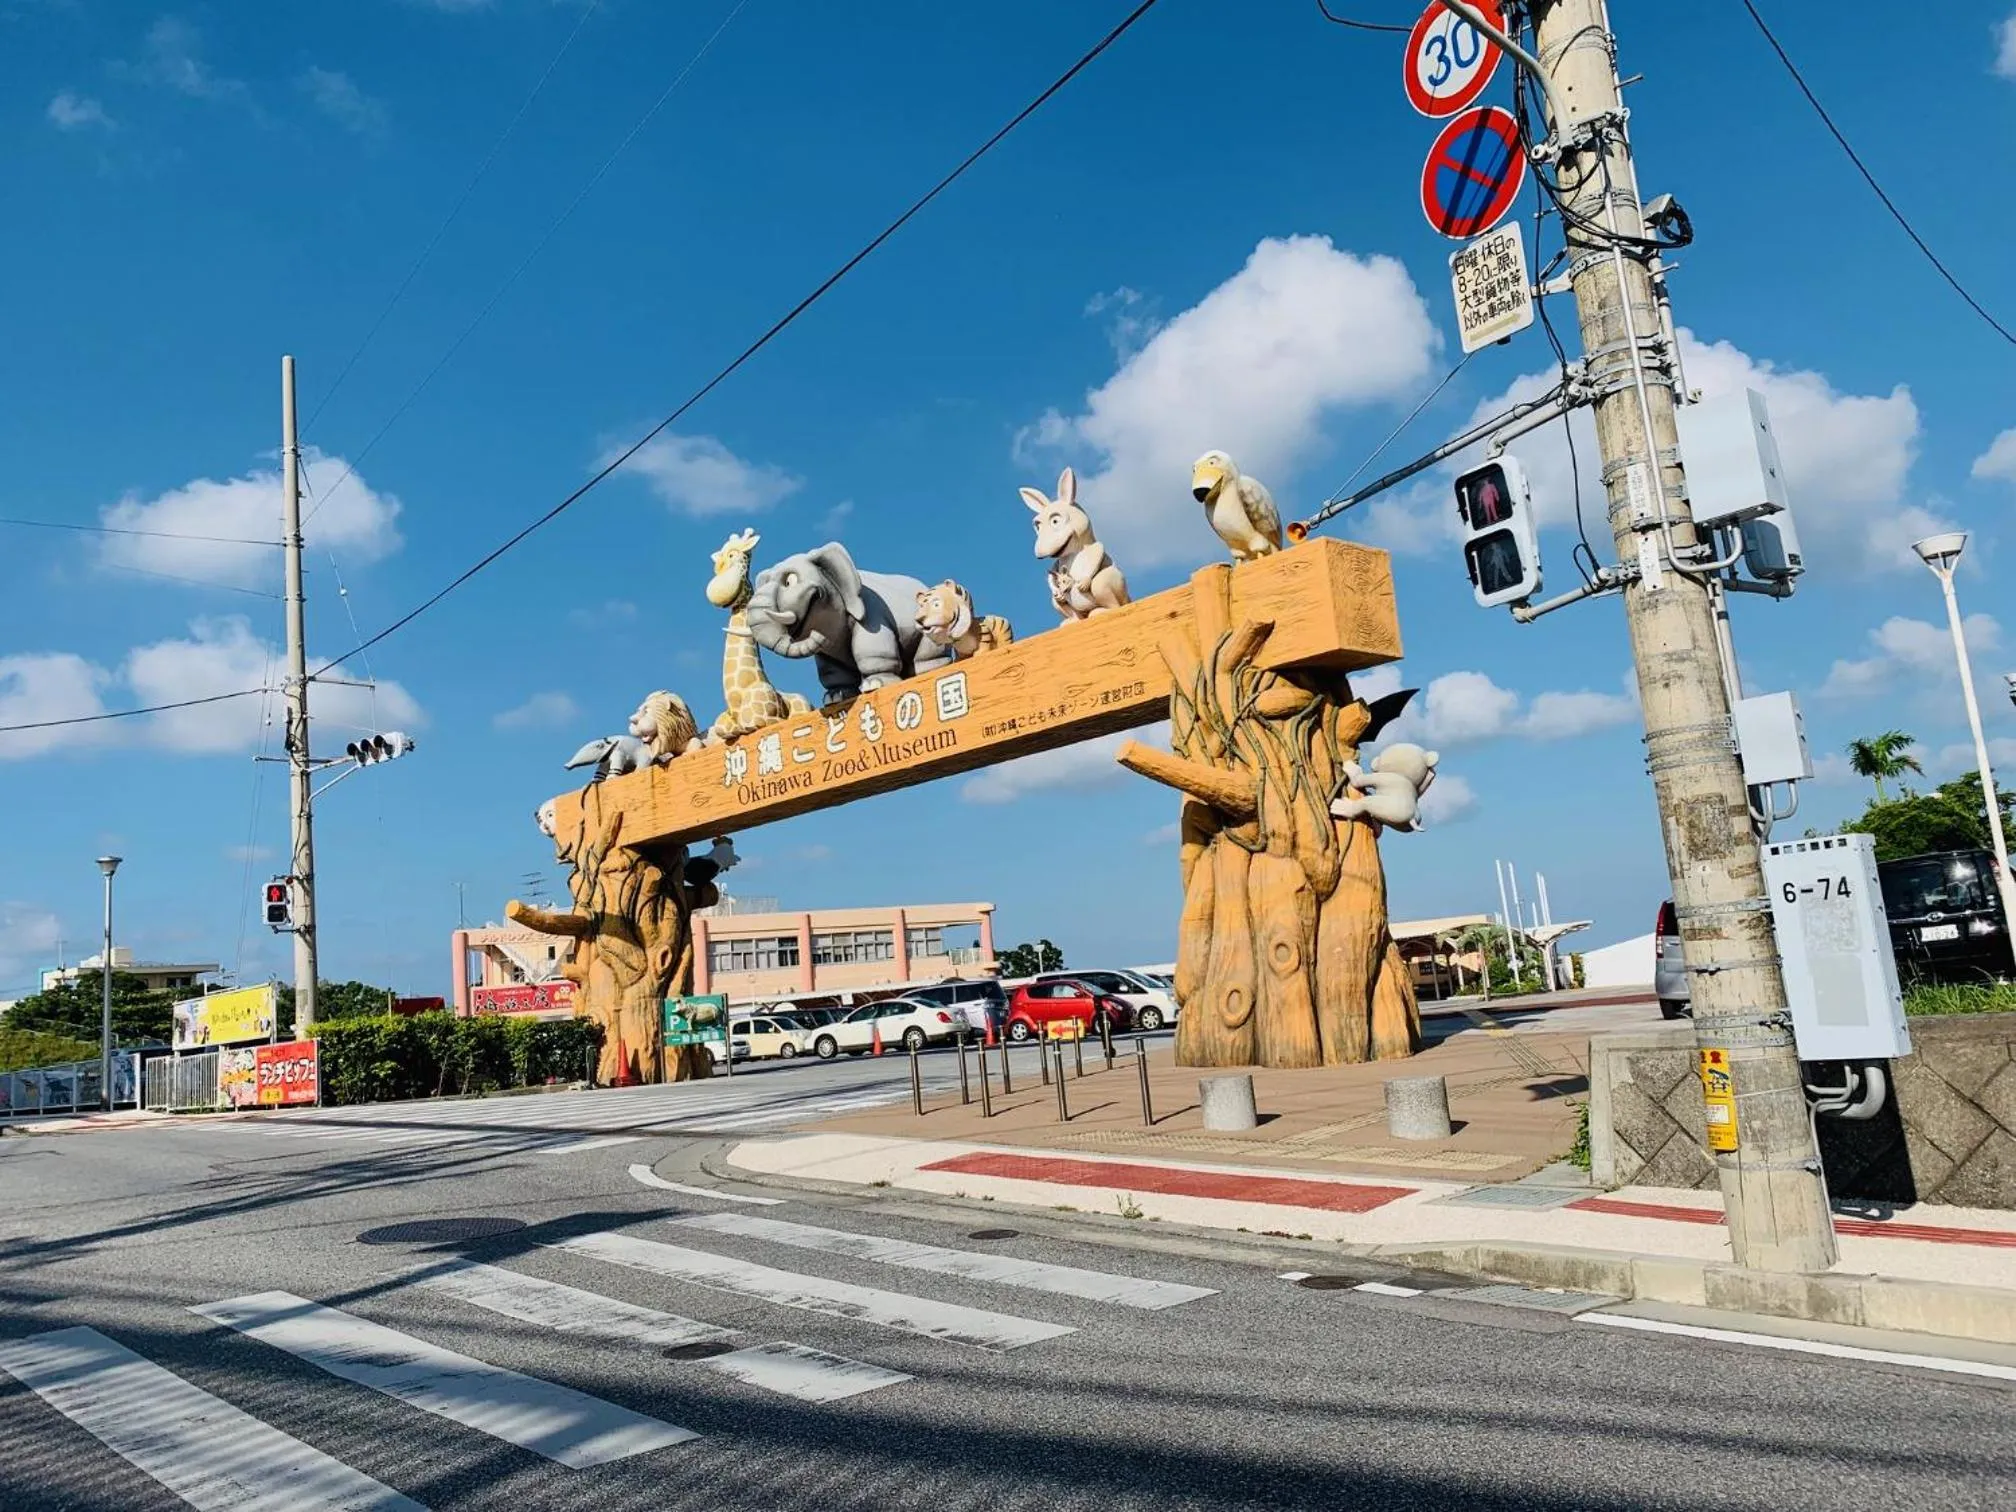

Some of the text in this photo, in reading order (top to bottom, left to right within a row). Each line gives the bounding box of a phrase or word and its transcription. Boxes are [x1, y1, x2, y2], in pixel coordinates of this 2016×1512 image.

[1425, 17, 1480, 86] 30
[723, 671, 970, 788] 沖縄こどもの国
[737, 770, 814, 806] Okinawa
[1782, 875, 1852, 904] 6-74
[670, 1015, 681, 1030] P
